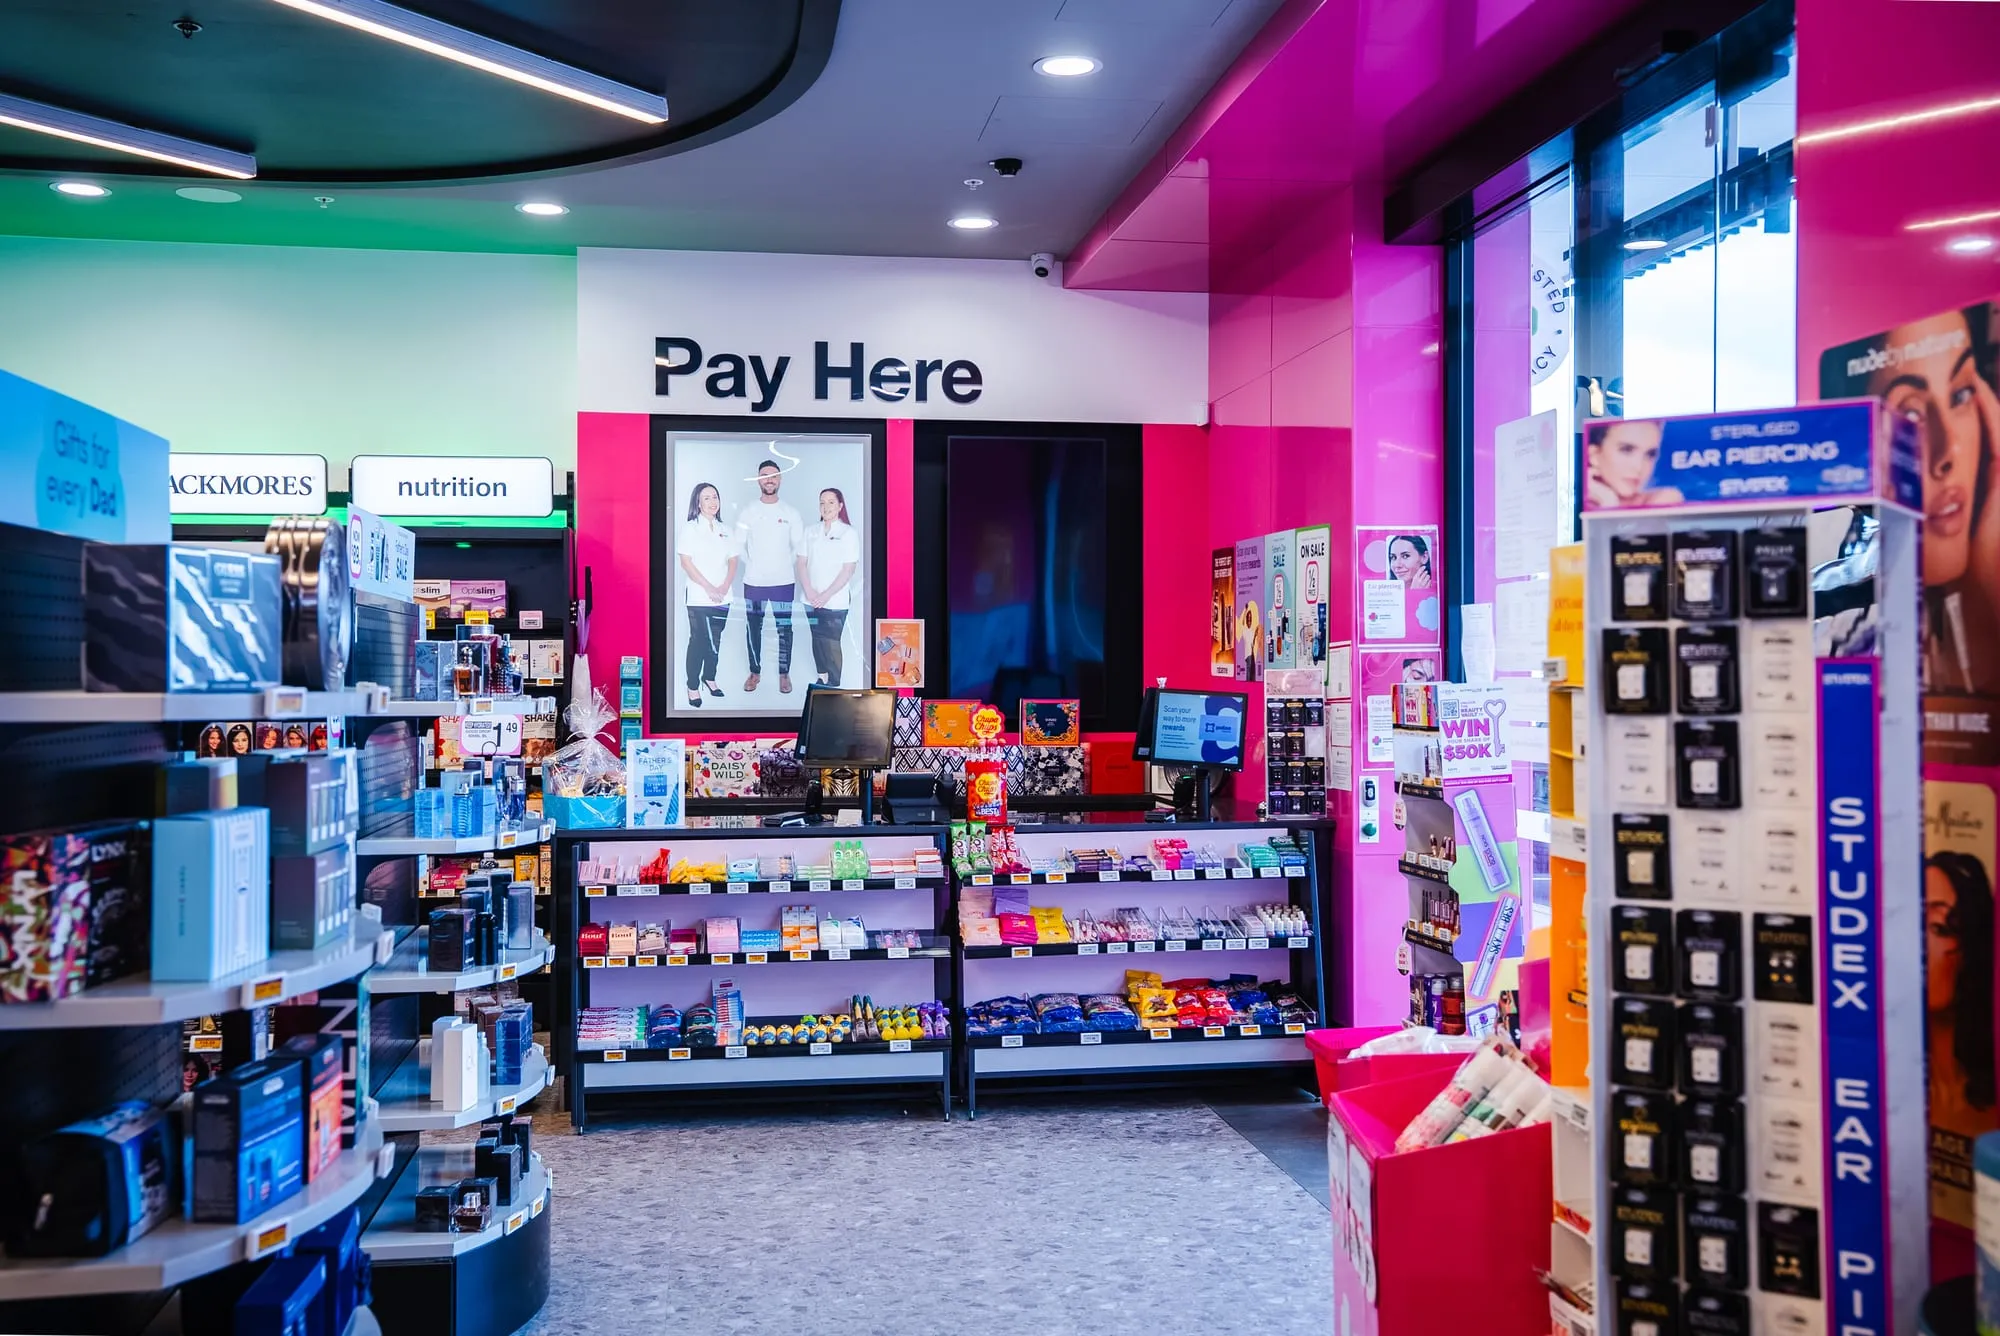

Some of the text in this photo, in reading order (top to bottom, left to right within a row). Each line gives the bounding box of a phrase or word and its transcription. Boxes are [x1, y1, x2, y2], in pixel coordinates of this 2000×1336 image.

[1532, 268, 1566, 314] STED
[655, 336, 983, 412] Pay Here
[54, 419, 111, 470] Gifts for
[1671, 440, 1840, 469] EAR PIERCING
[168, 475, 313, 496] ACKMORES
[399, 476, 508, 497] nutrition
[46, 475, 117, 518] every Dad
[1273, 553, 1285, 568] SALE
[1300, 544, 1310, 558] ON
[1310, 542, 1325, 557] SALE
[441, 714, 460, 723] SHA
[524, 713, 556, 723] SHAKE
[975, 714, 999, 723] Chupa
[1163, 705, 1178, 713] Scan
[493, 723, 502, 747] 1
[506, 722, 518, 733] 49
[974, 721, 999, 731] Chups
[1441, 718, 1490, 739] WIN
[1443, 743, 1492, 762] $50K
[649, 764, 664, 772] DAY
[711, 762, 747, 770] DAISY
[91, 840, 127, 862] LYNX
[1829, 796, 1869, 1010] STUDEX
[1833, 1078, 1873, 1184] EAR
